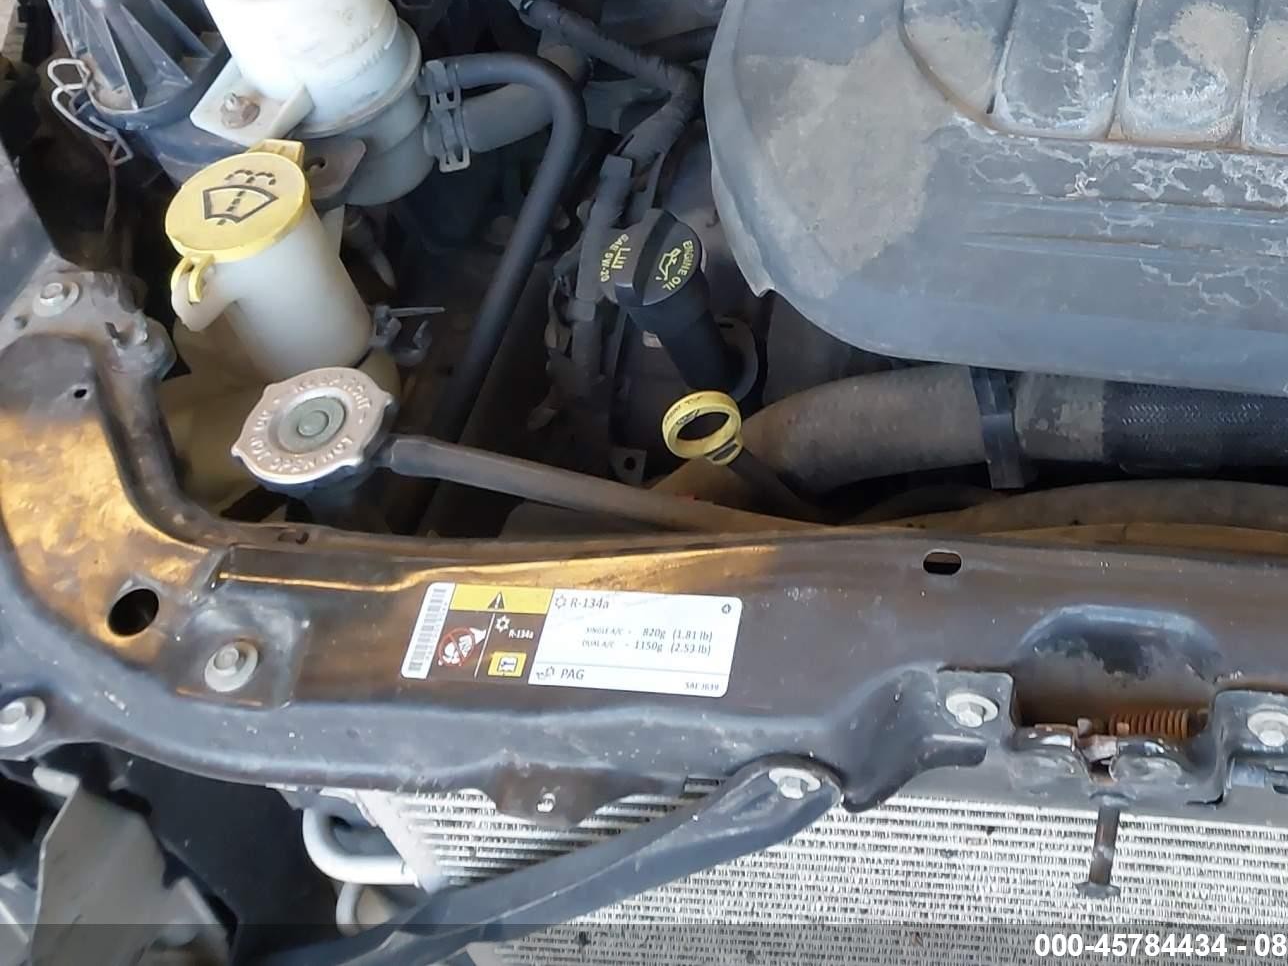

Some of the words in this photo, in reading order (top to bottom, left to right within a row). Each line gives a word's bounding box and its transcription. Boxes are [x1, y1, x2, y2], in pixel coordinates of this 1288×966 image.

[677, 239, 694, 276] ENGINE
[661, 276, 682, 291] OIL
[570, 597, 609, 610] R-134a
[642, 628, 666, 640] 820g
[635, 640, 663, 653] 1150g
[561, 668, 585, 680] PAG
